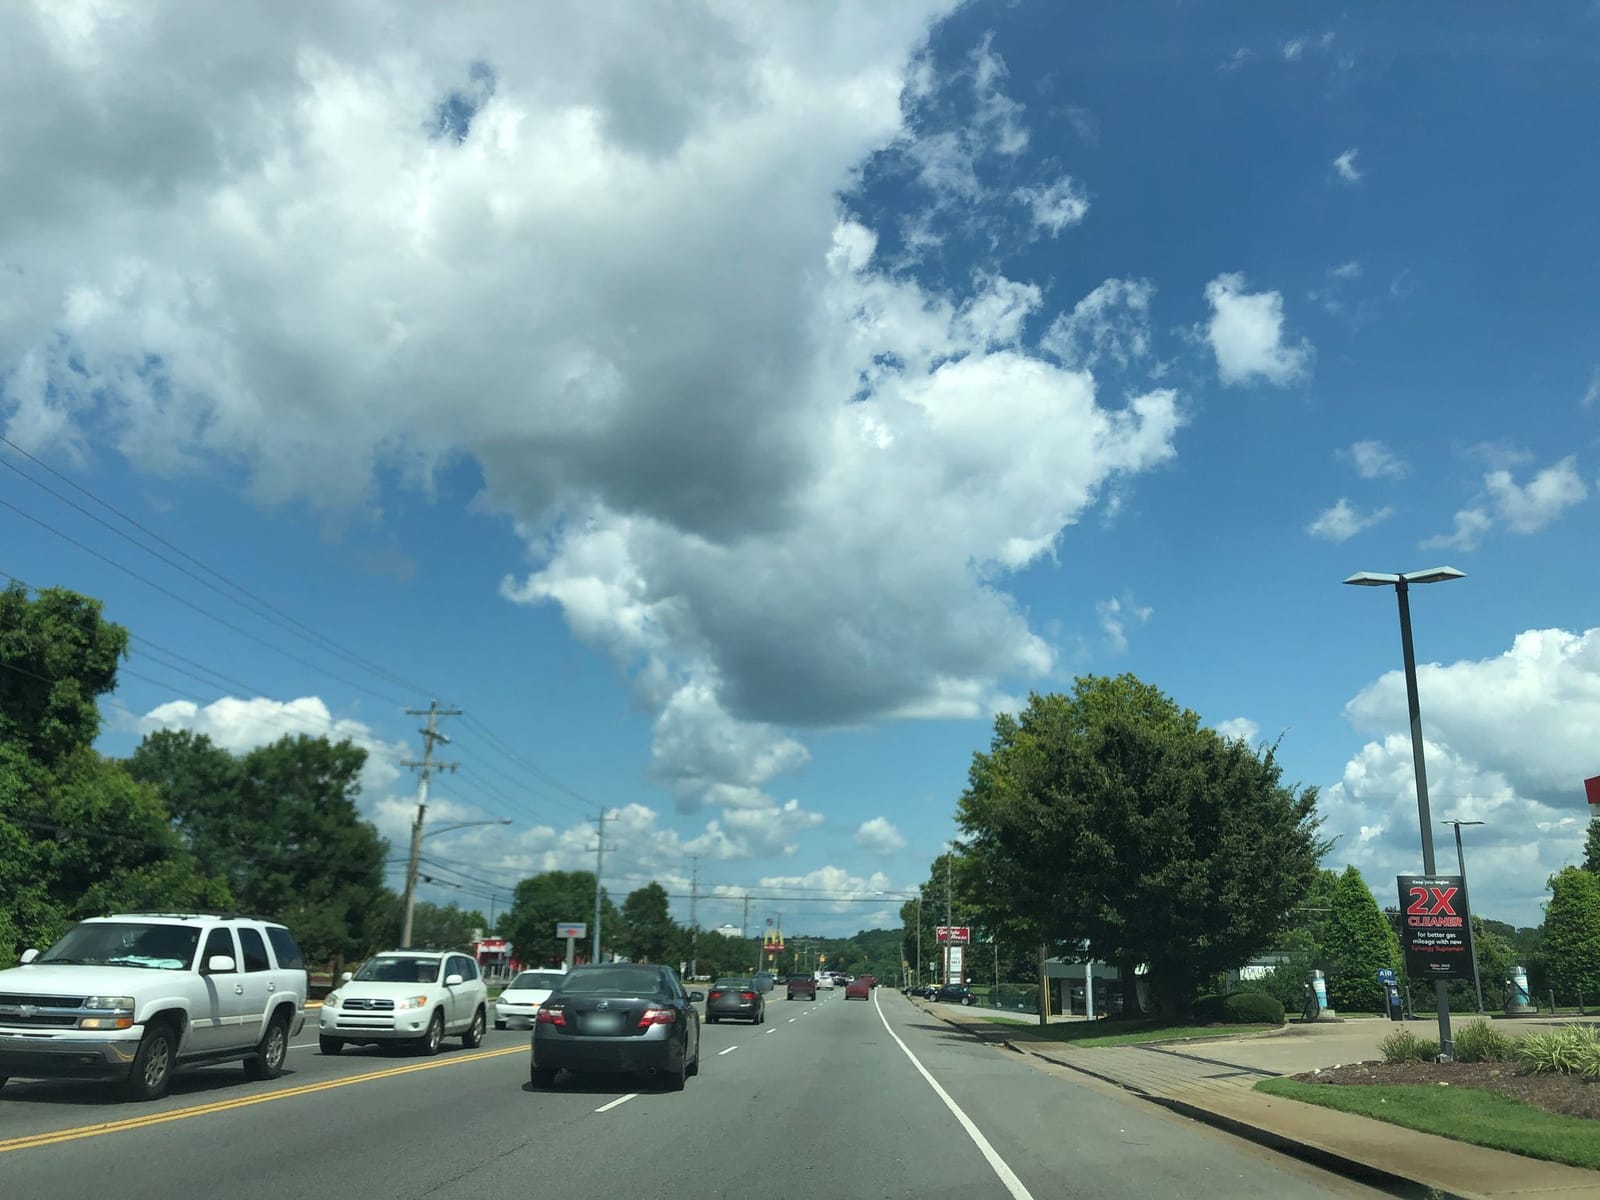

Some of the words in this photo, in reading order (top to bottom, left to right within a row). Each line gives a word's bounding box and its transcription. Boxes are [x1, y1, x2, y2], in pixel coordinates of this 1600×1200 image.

[1407, 886, 1458, 915] 2X
[1407, 916, 1462, 927] CLEANER
[1412, 938, 1435, 946] mileage
